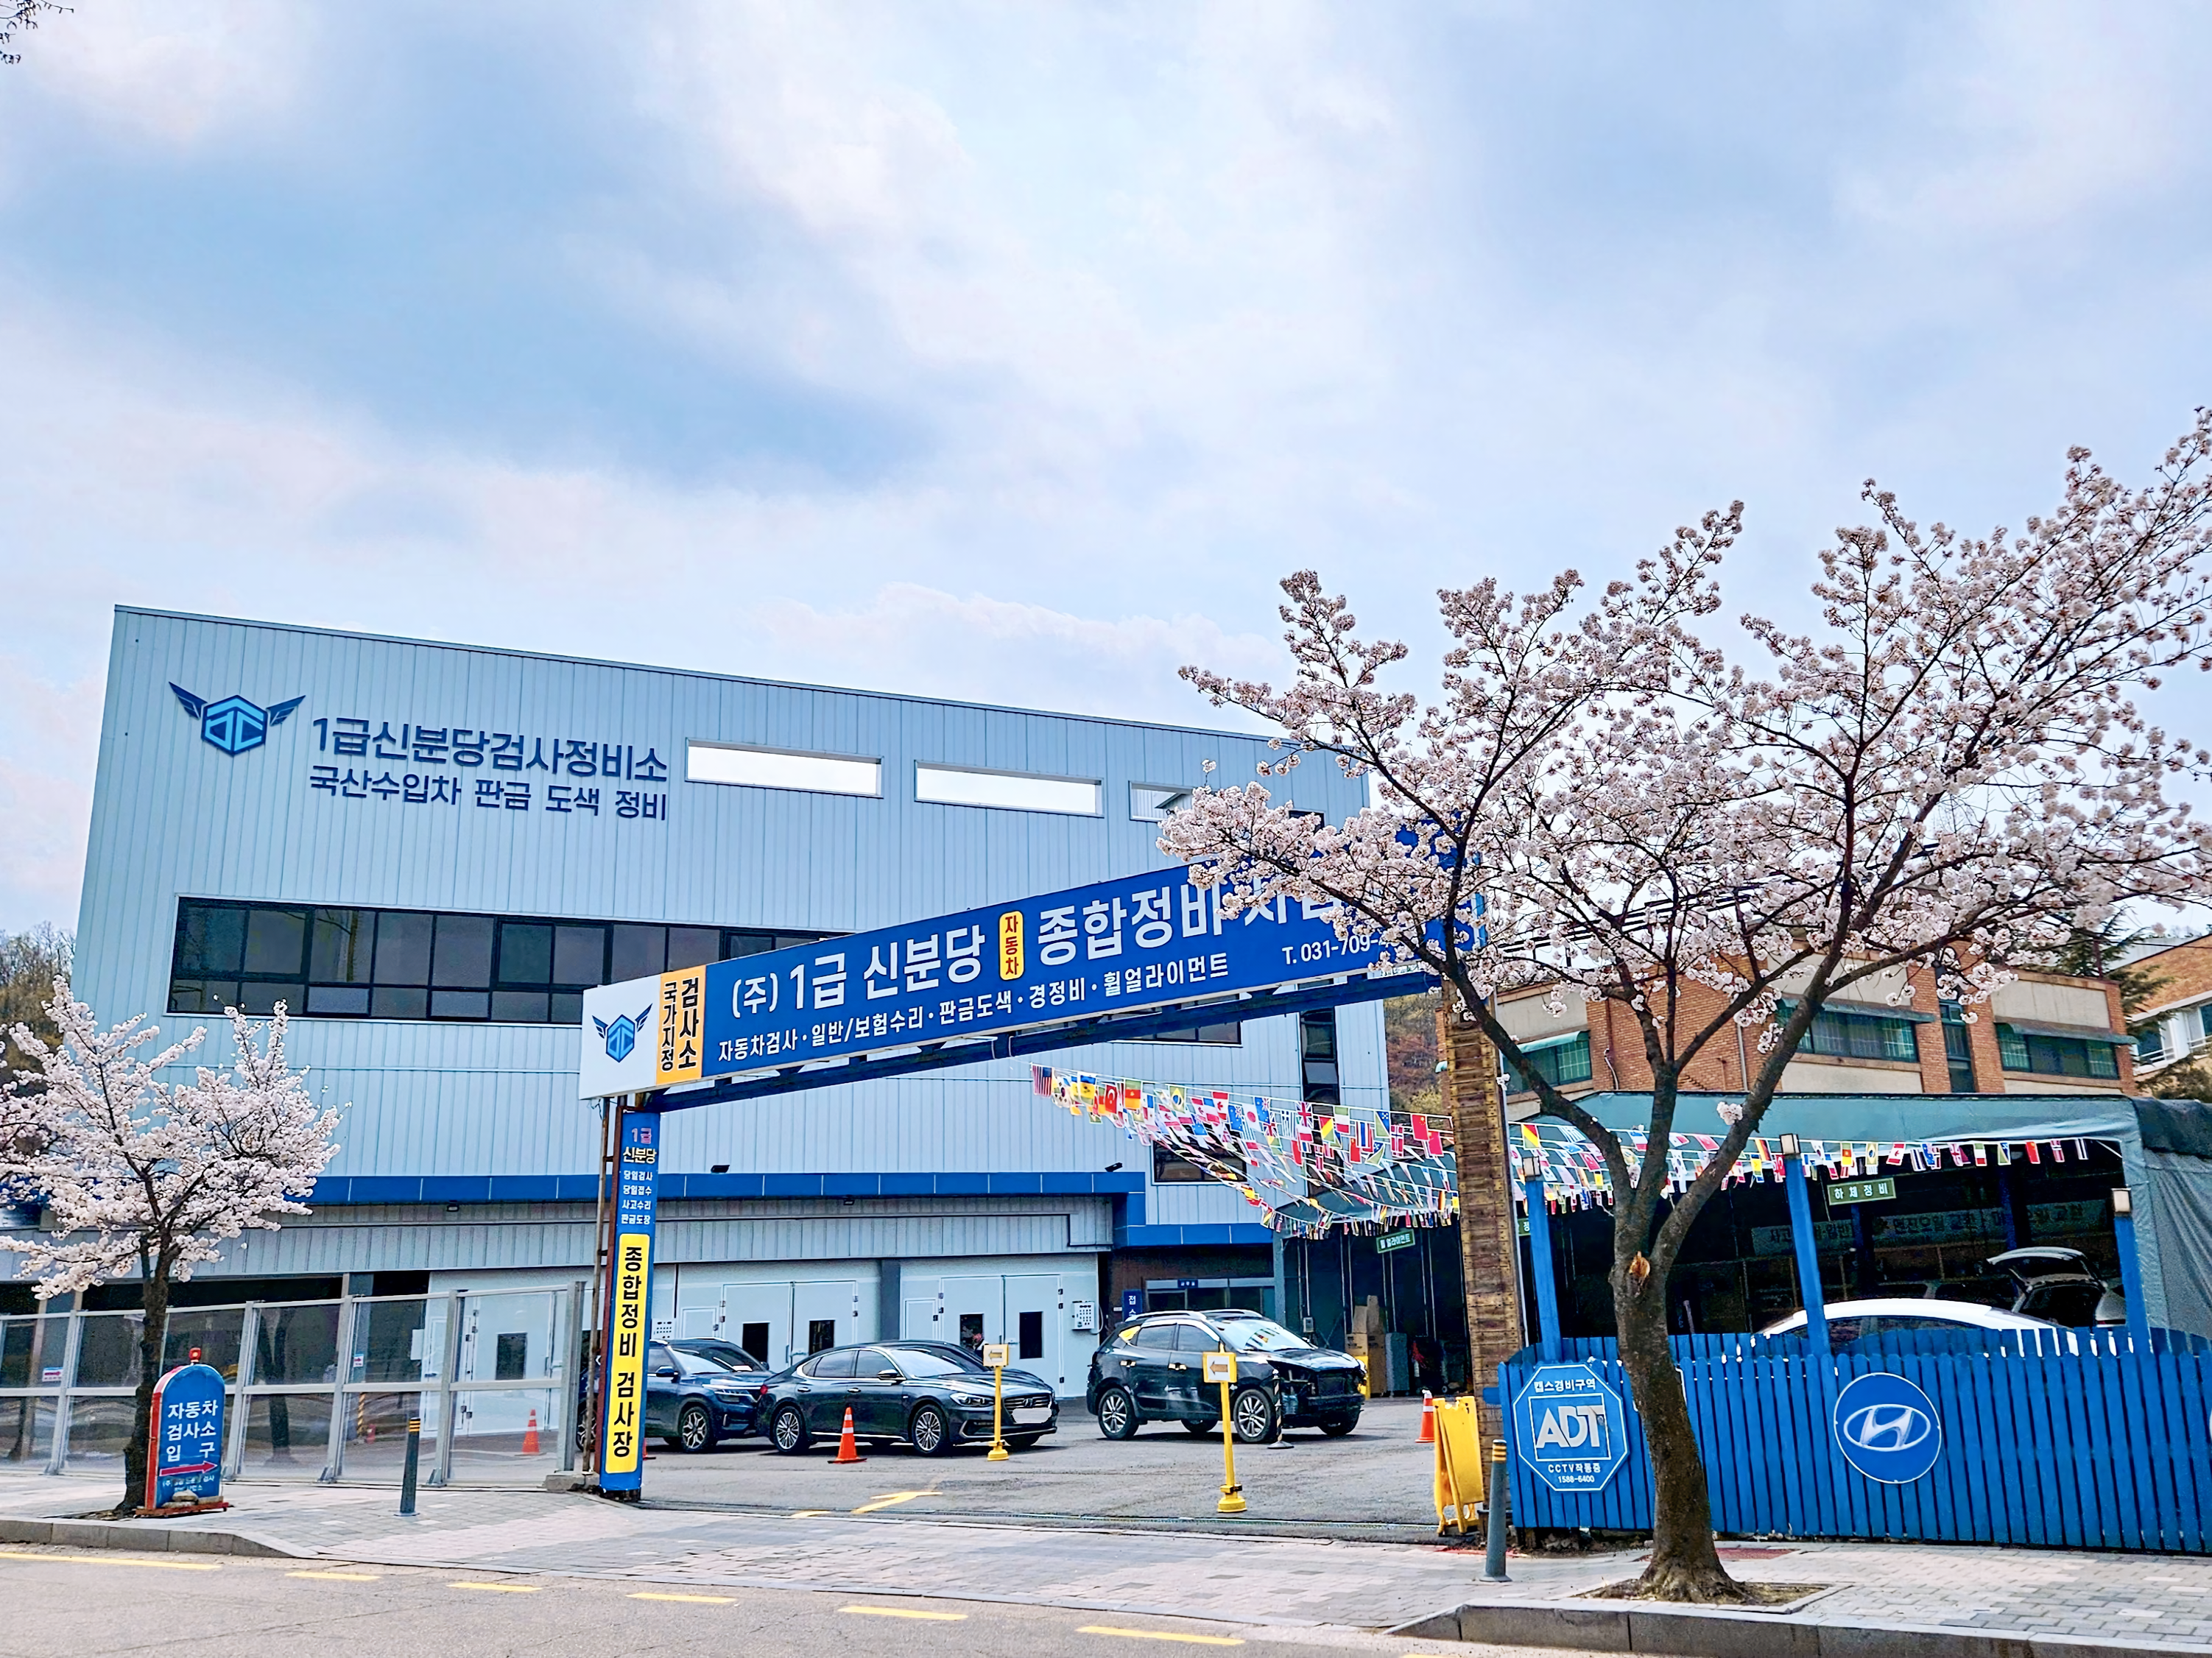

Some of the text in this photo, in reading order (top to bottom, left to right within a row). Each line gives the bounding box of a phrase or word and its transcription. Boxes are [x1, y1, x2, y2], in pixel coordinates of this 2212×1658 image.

[313, 717, 668, 783] 1급신분당검사정비소
[309, 765, 666, 821] 국산수입차 판금 도색 정비
[1004, 915, 1019, 976] 자동차
[1300, 934, 1389, 962] 031-709-
[732, 924, 985, 1018] (주) 1급 신분당
[718, 953, 1228, 1062] 자동차검사 일반/보험수리 판금도색 경정비 휠얼라이먼트
[661, 981, 677, 1071] 국가지정
[678, 977, 700, 1070] 검사소
[631, 1128, 652, 1144] 1급
[622, 1146, 657, 1165] 신분당
[624, 1170, 653, 1181] 당일검사
[621, 1199, 652, 1210] 사고수리
[623, 1185, 652, 1196] 당일접수
[621, 1214, 651, 1225] 판금도장
[619, 1246, 642, 1358] 종합정비
[1534, 1378, 1596, 1393] 캡스경비구역
[167, 1400, 219, 1419] 자동차
[613, 1372, 635, 1458] 검사장
[166, 1420, 216, 1441] 검사소
[1535, 1405, 1605, 1449] ADT
[1557, 1475, 1595, 1483] 1588-6400
